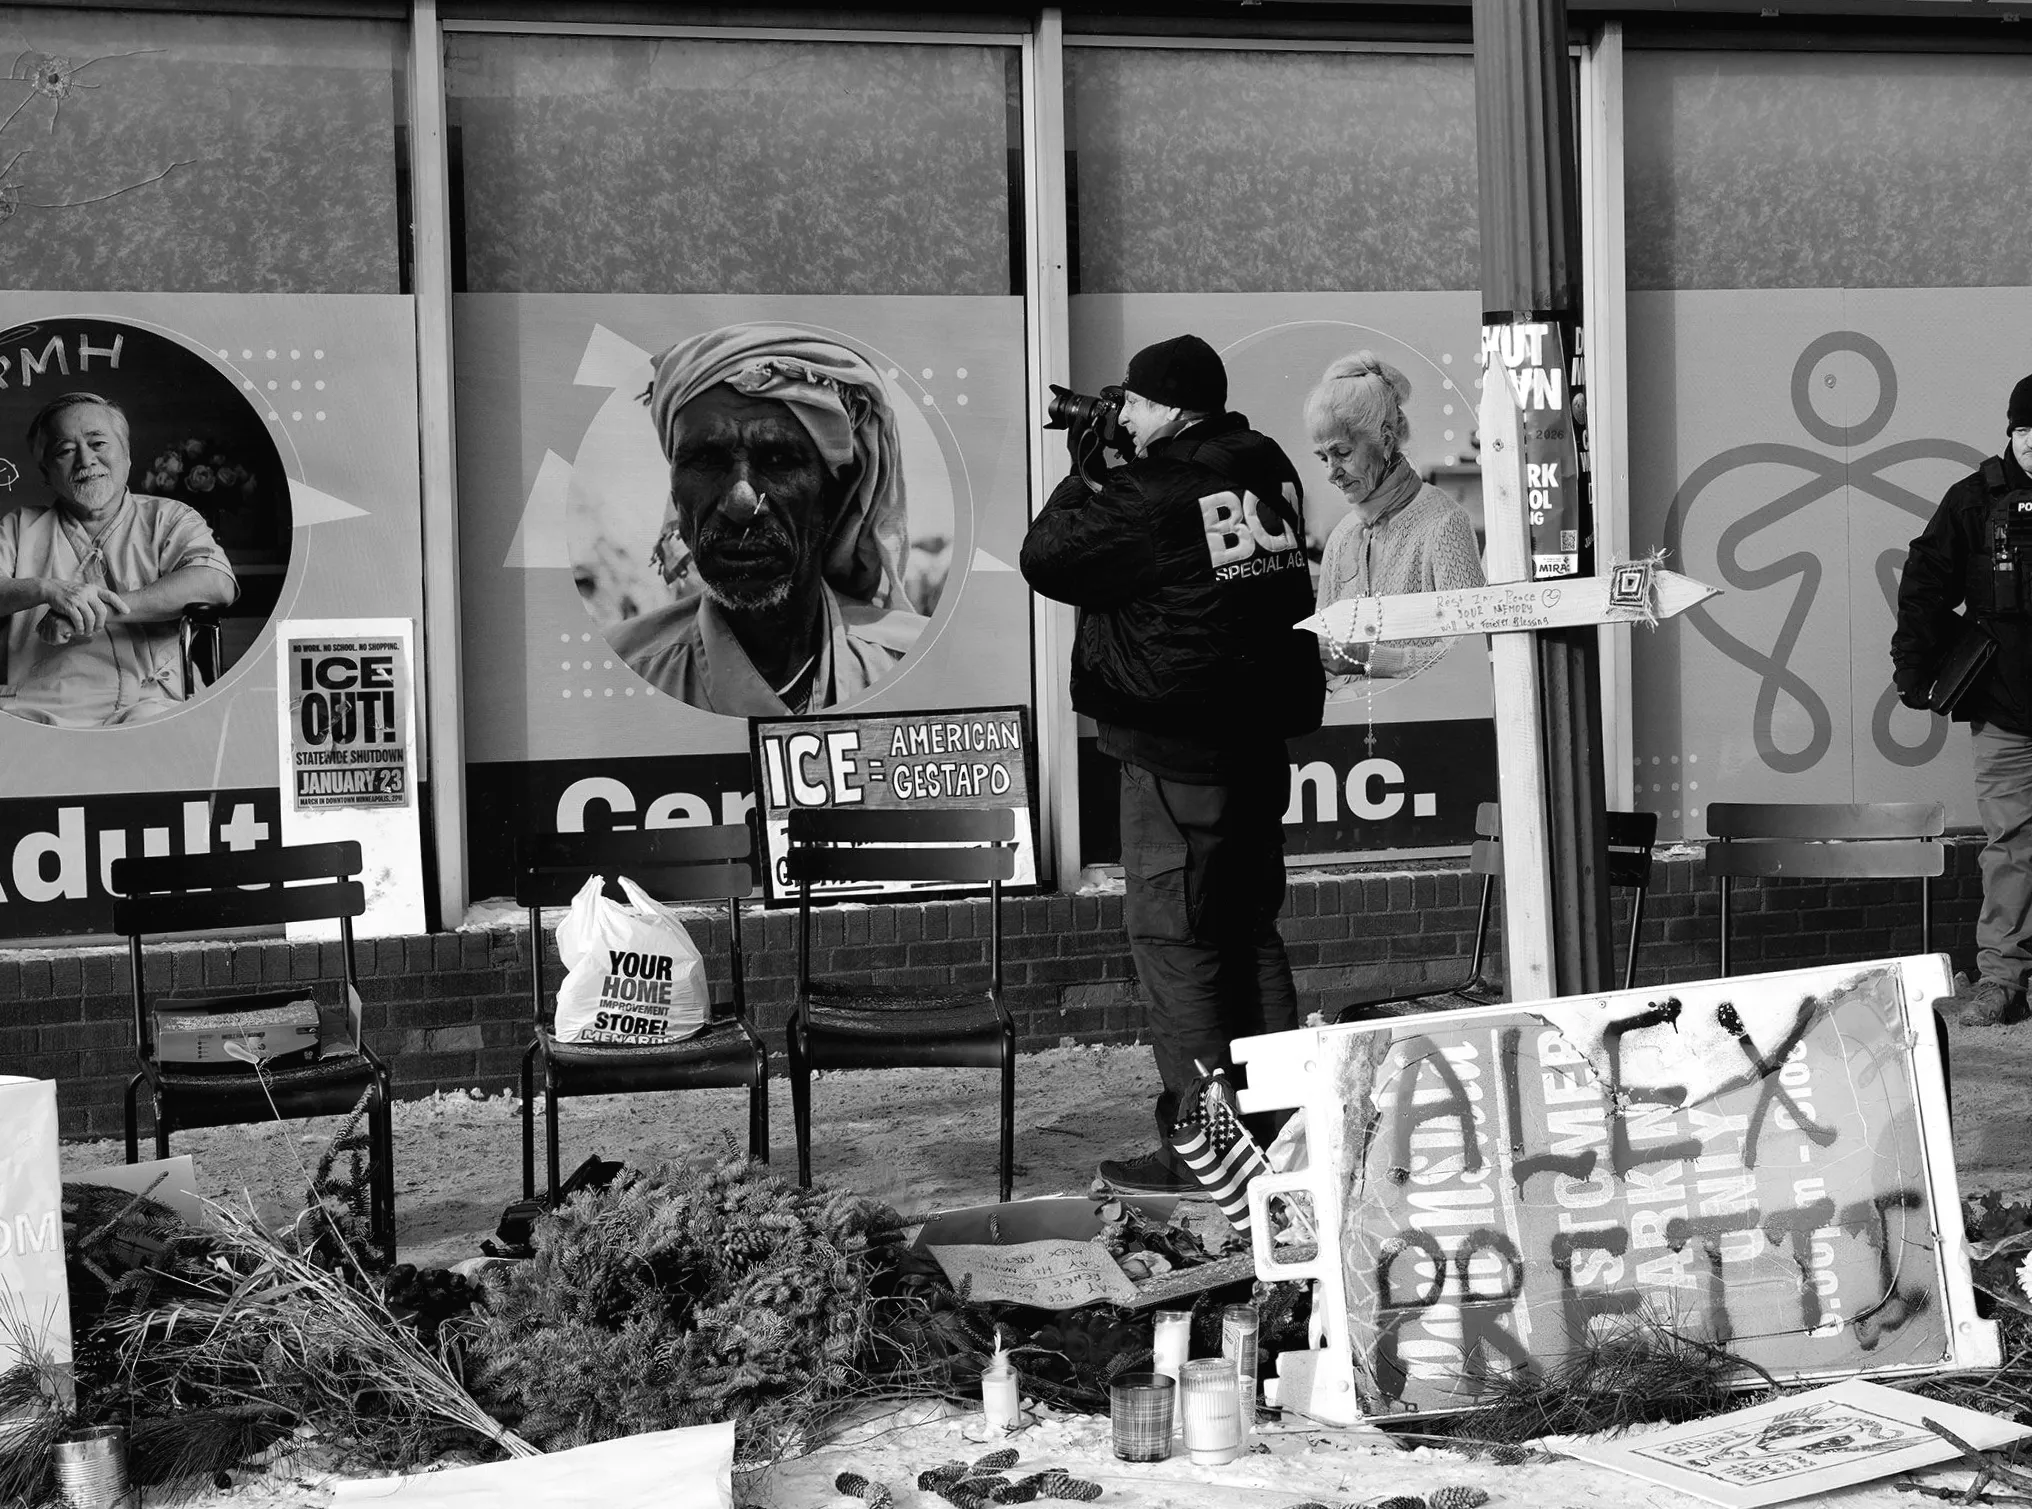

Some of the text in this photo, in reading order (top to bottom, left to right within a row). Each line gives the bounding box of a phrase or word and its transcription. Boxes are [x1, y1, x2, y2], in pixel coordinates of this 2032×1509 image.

[1536, 430, 1565, 440] 2026
[1216, 555, 1283, 582] SPECIAL
[1505, 590, 1536, 605] Peace
[293, 642, 399, 653] NO WORK. NO SCHOOL. NO SHOPPING.
[300, 656, 394, 691] ICE
[301, 691, 396, 746] OUT!
[296, 750, 348, 766] STATEWIDE
[350, 748, 403, 764] SHUTDOWN
[763, 730, 865, 809] ICE
[890, 721, 1021, 757] AMERICAN
[300, 768, 402, 795] JANUARY 23
[892, 762, 1011, 800] GESTAPO
[300, 797, 318, 806] MARCH
[319, 797, 325, 805] IN
[325, 796, 355, 805] DOWNTOWN
[609, 950, 673, 981] YOUR
[601, 976, 673, 1005] HOME
[599, 999, 669, 1017] IMPROVEMENT
[594, 1011, 668, 1036] STORE!
